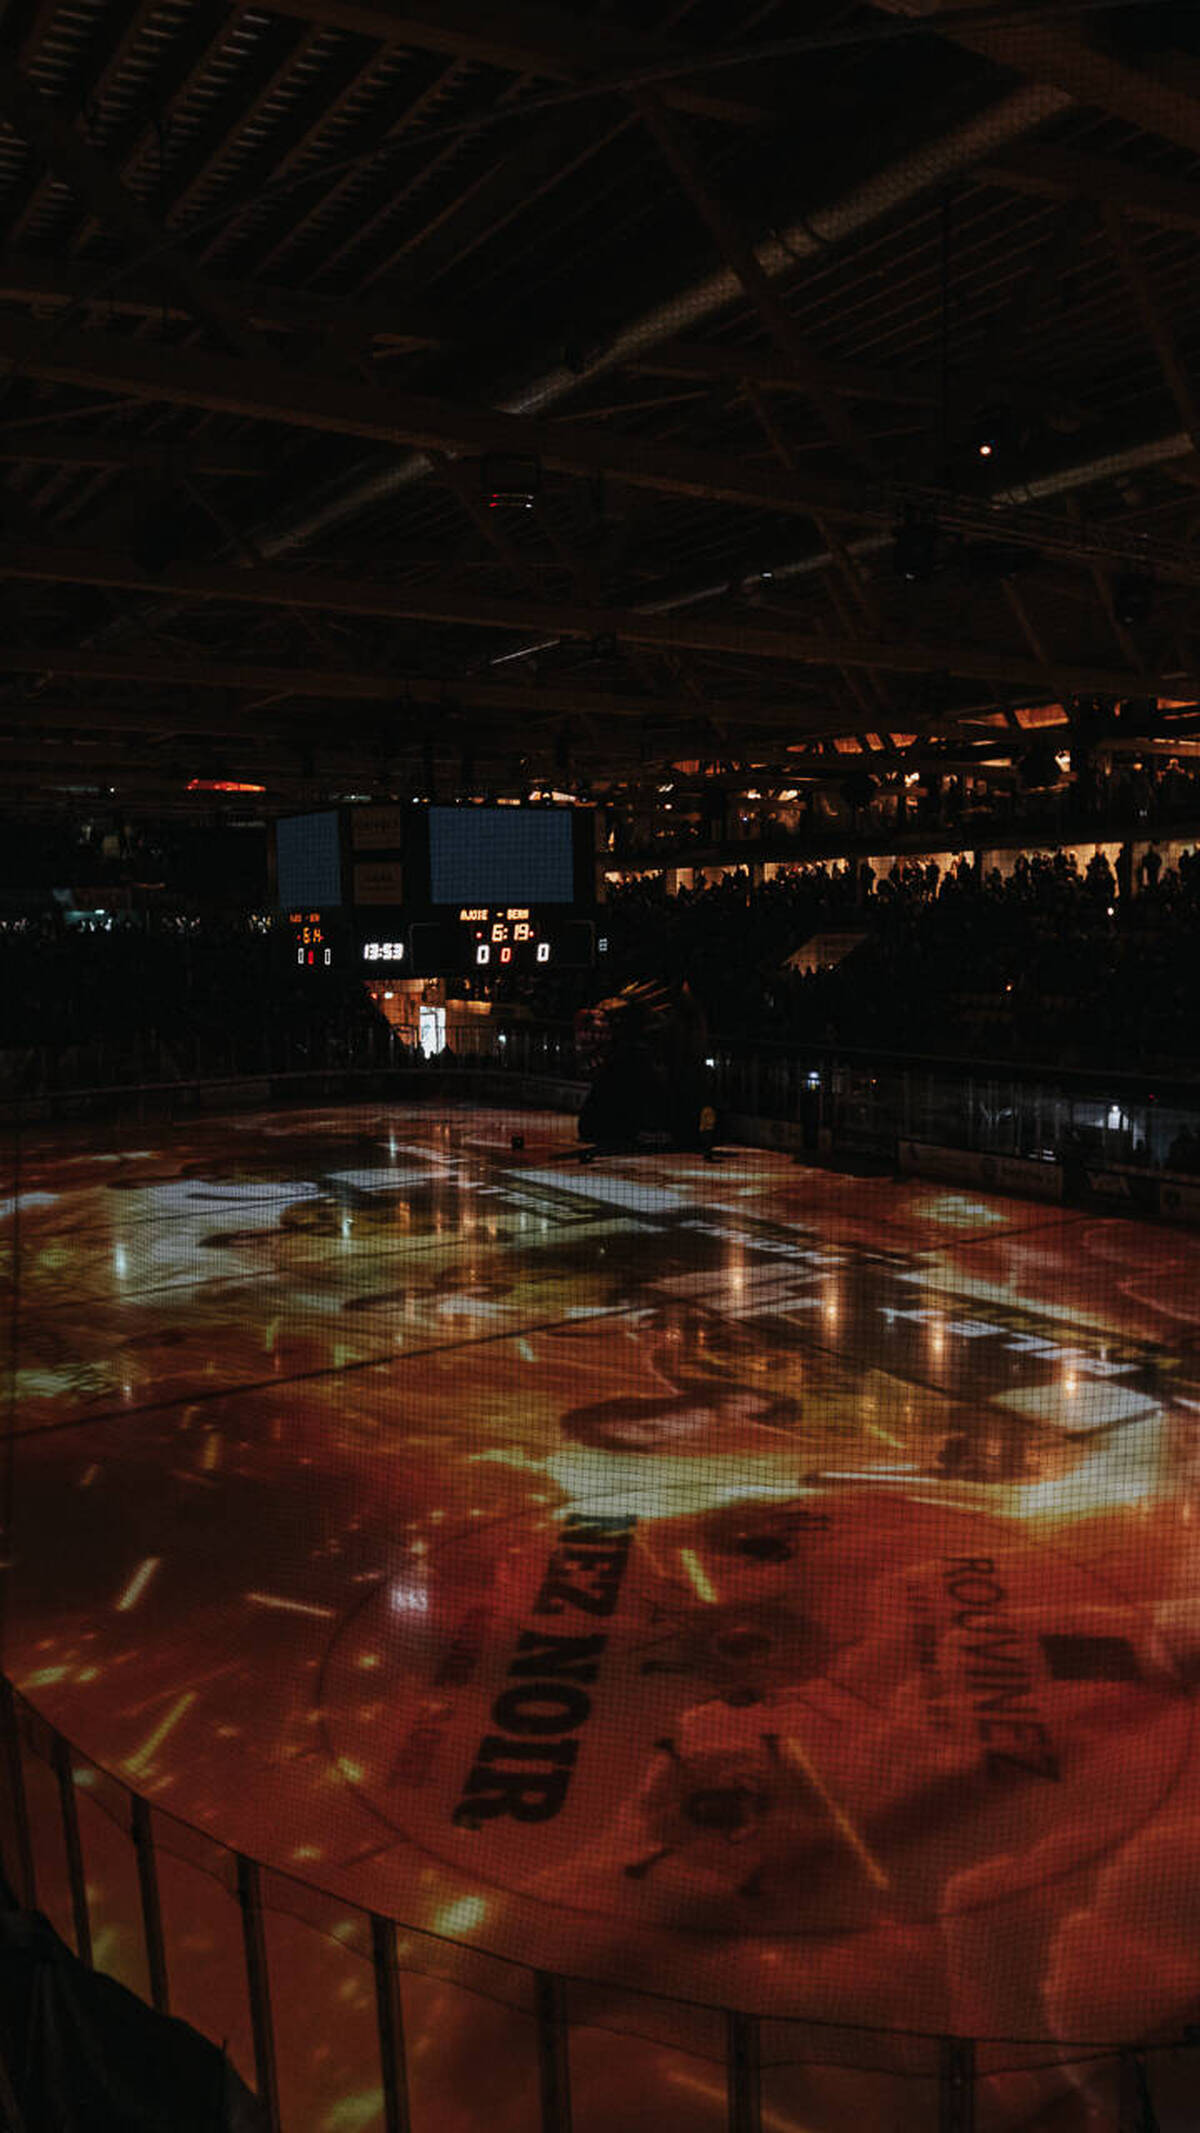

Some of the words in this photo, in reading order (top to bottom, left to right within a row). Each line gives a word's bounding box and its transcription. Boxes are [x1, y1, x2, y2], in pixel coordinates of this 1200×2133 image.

[363, 942, 404, 960] 13:53
[477, 944, 490, 964] 0
[501, 947, 511, 963] 0
[537, 943, 550, 962] 0
[941, 1557, 1061, 1782] ROUVINEZ
[453, 1630, 608, 1831] NOIR
